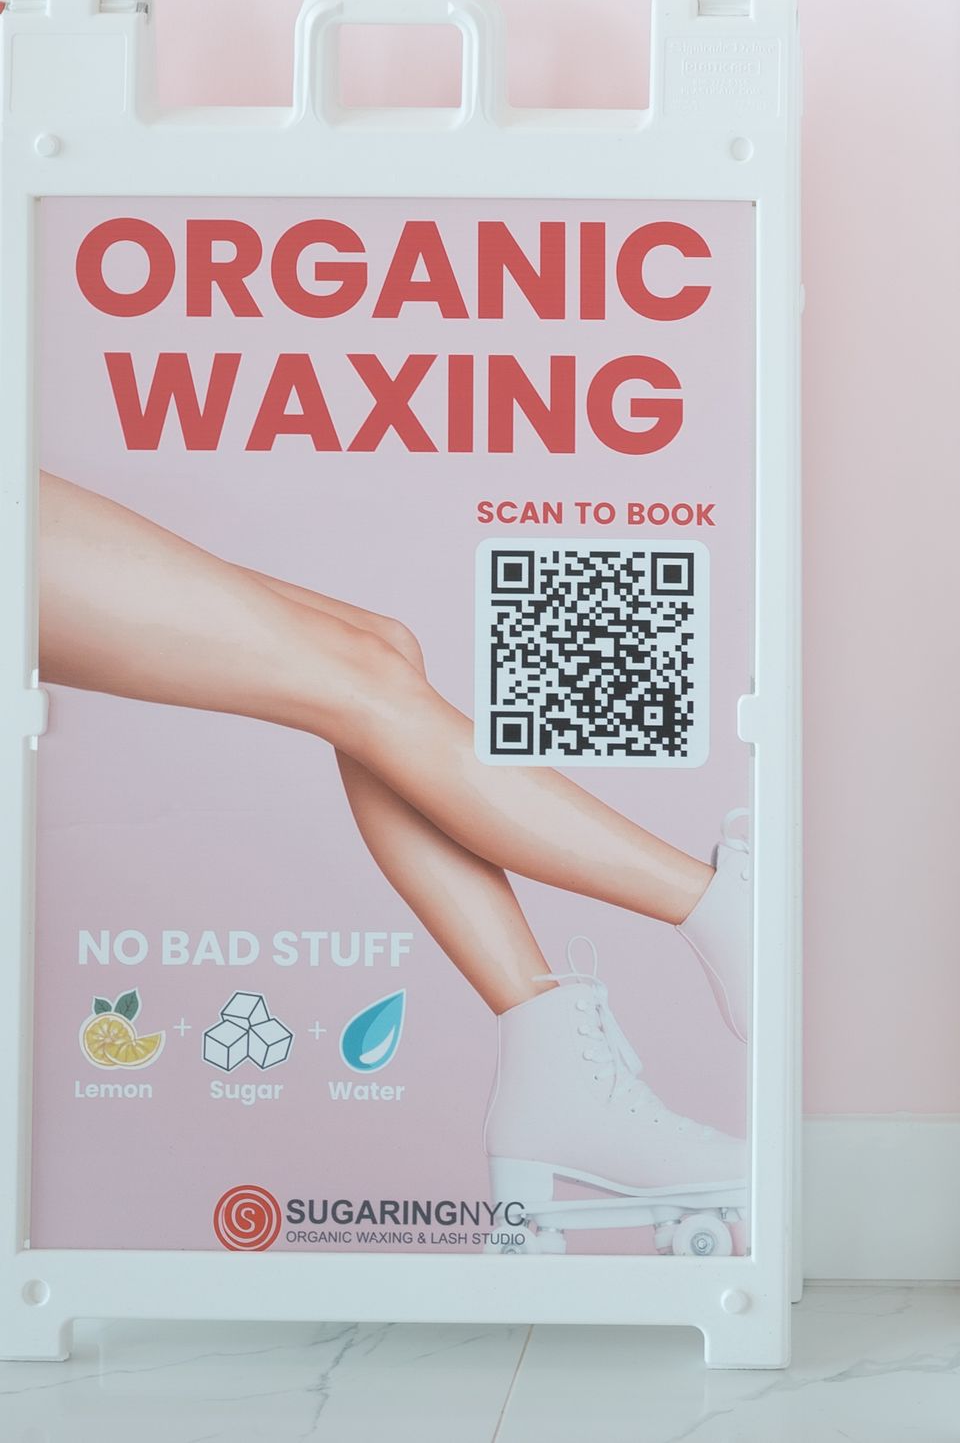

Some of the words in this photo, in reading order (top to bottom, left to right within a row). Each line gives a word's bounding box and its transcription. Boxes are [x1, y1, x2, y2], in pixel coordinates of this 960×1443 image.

[75, 217, 713, 321] ORGANIC
[104, 352, 684, 455] WAXING
[477, 501, 563, 526] SCAN
[575, 501, 615, 526] TO
[627, 503, 716, 527] BOOK
[78, 930, 149, 966] NO
[161, 930, 260, 967] BAD
[272, 930, 413, 968] STUFF
[75, 1079, 152, 1099] Lemon
[210, 1079, 283, 1106] Sugar
[329, 1080, 405, 1101] Water
[286, 1199, 526, 1226] SUGARINGNYC
[286, 1231, 352, 1244] ORGANIC
[356, 1231, 414, 1244] WAXING
[418, 1231, 426, 1244] &
[430, 1232, 468, 1245] LASH
[472, 1232, 526, 1246] STUDIO
